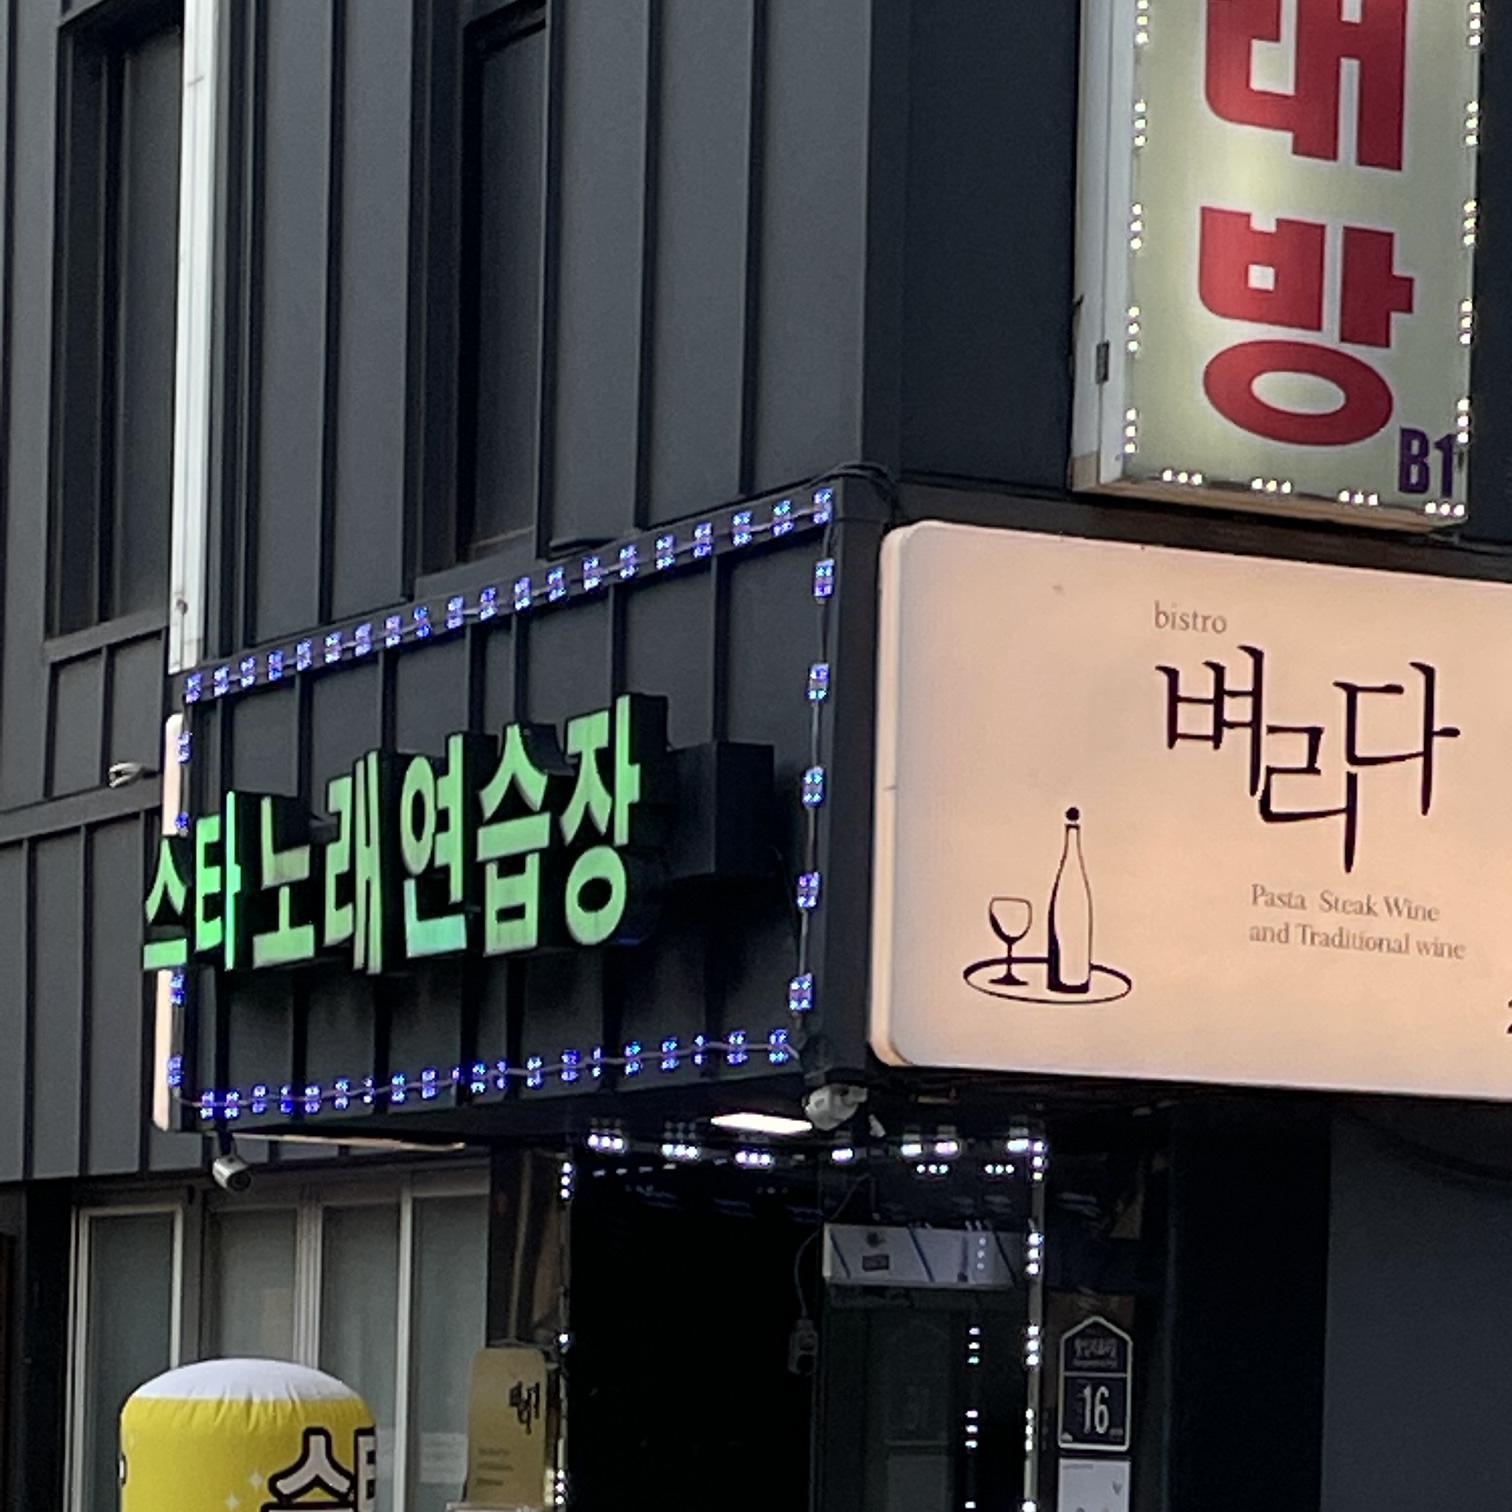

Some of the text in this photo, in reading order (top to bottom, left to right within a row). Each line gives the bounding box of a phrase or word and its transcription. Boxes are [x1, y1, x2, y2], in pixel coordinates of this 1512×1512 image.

[1400, 428, 1457, 498] B1
[1153, 600, 1228, 635] bistro
[1155, 645, 1461, 873] 벼리다
[1251, 883, 1440, 922] Pasta Steak Wine
[1249, 922, 1467, 960] and Traditional wine
[1082, 1383, 1110, 1434] 16
